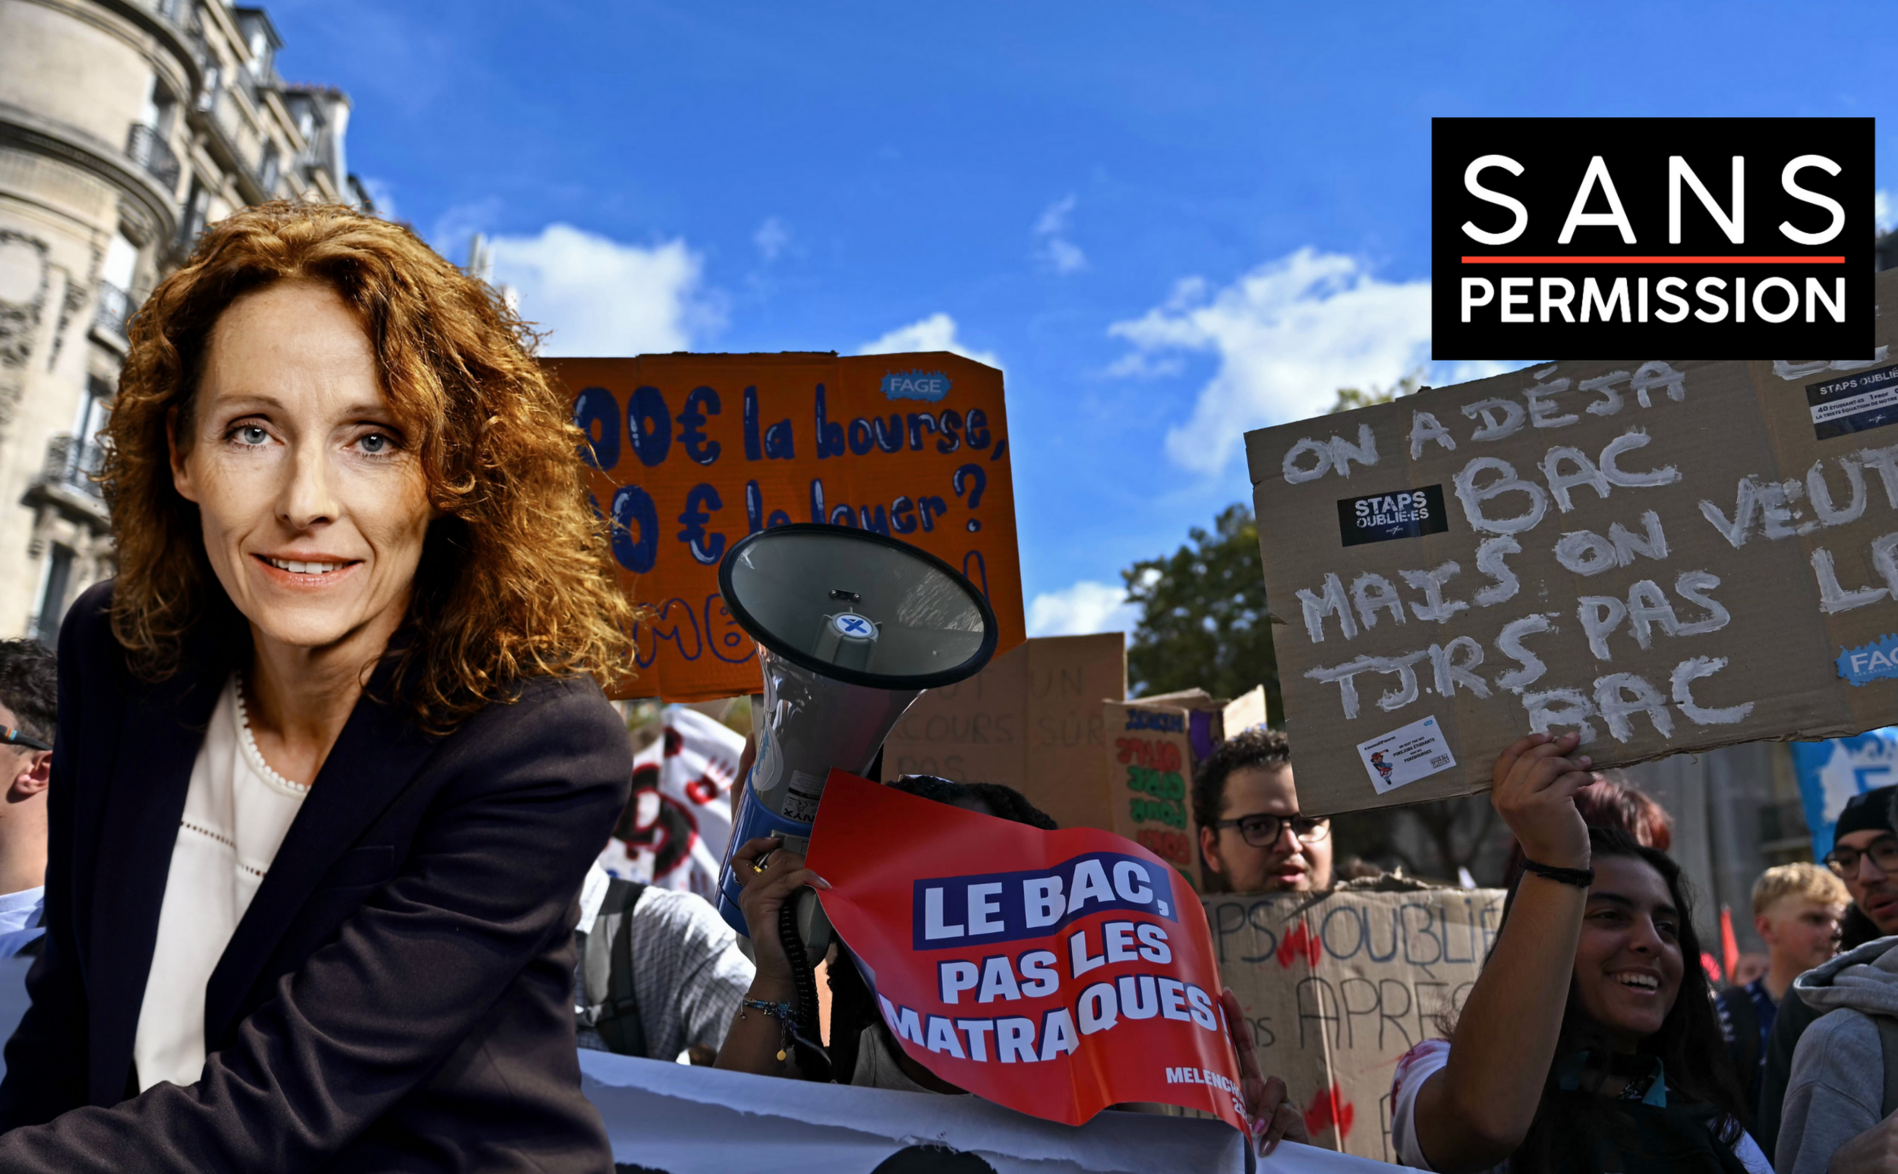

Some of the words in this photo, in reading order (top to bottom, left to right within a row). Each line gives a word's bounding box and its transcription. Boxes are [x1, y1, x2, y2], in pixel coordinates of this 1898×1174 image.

[743, 386, 795, 461] la
[815, 383, 1007, 461] bourse,
[890, 377, 942, 393] FAGE
[1820, 379, 1858, 395] STAPS
[1282, 423, 1380, 484] ON
[1407, 409, 1456, 460] A
[1452, 426, 1682, 534] BAC
[1355, 491, 1428, 517] STAPS
[1294, 532, 1524, 644] MAIS
[1553, 509, 1670, 577] ON
[1577, 569, 1732, 662] PAS
[893, 712, 1015, 745] COURS
[1521, 655, 1755, 745] BAC
[924, 881, 1005, 940] LE
[1022, 858, 1170, 929] BAC,
[1203, 899, 1277, 964] PS
[939, 950, 1060, 1004] PAS
[1069, 920, 1172, 980] LES
[878, 975, 1218, 1063] MATRAQUES
